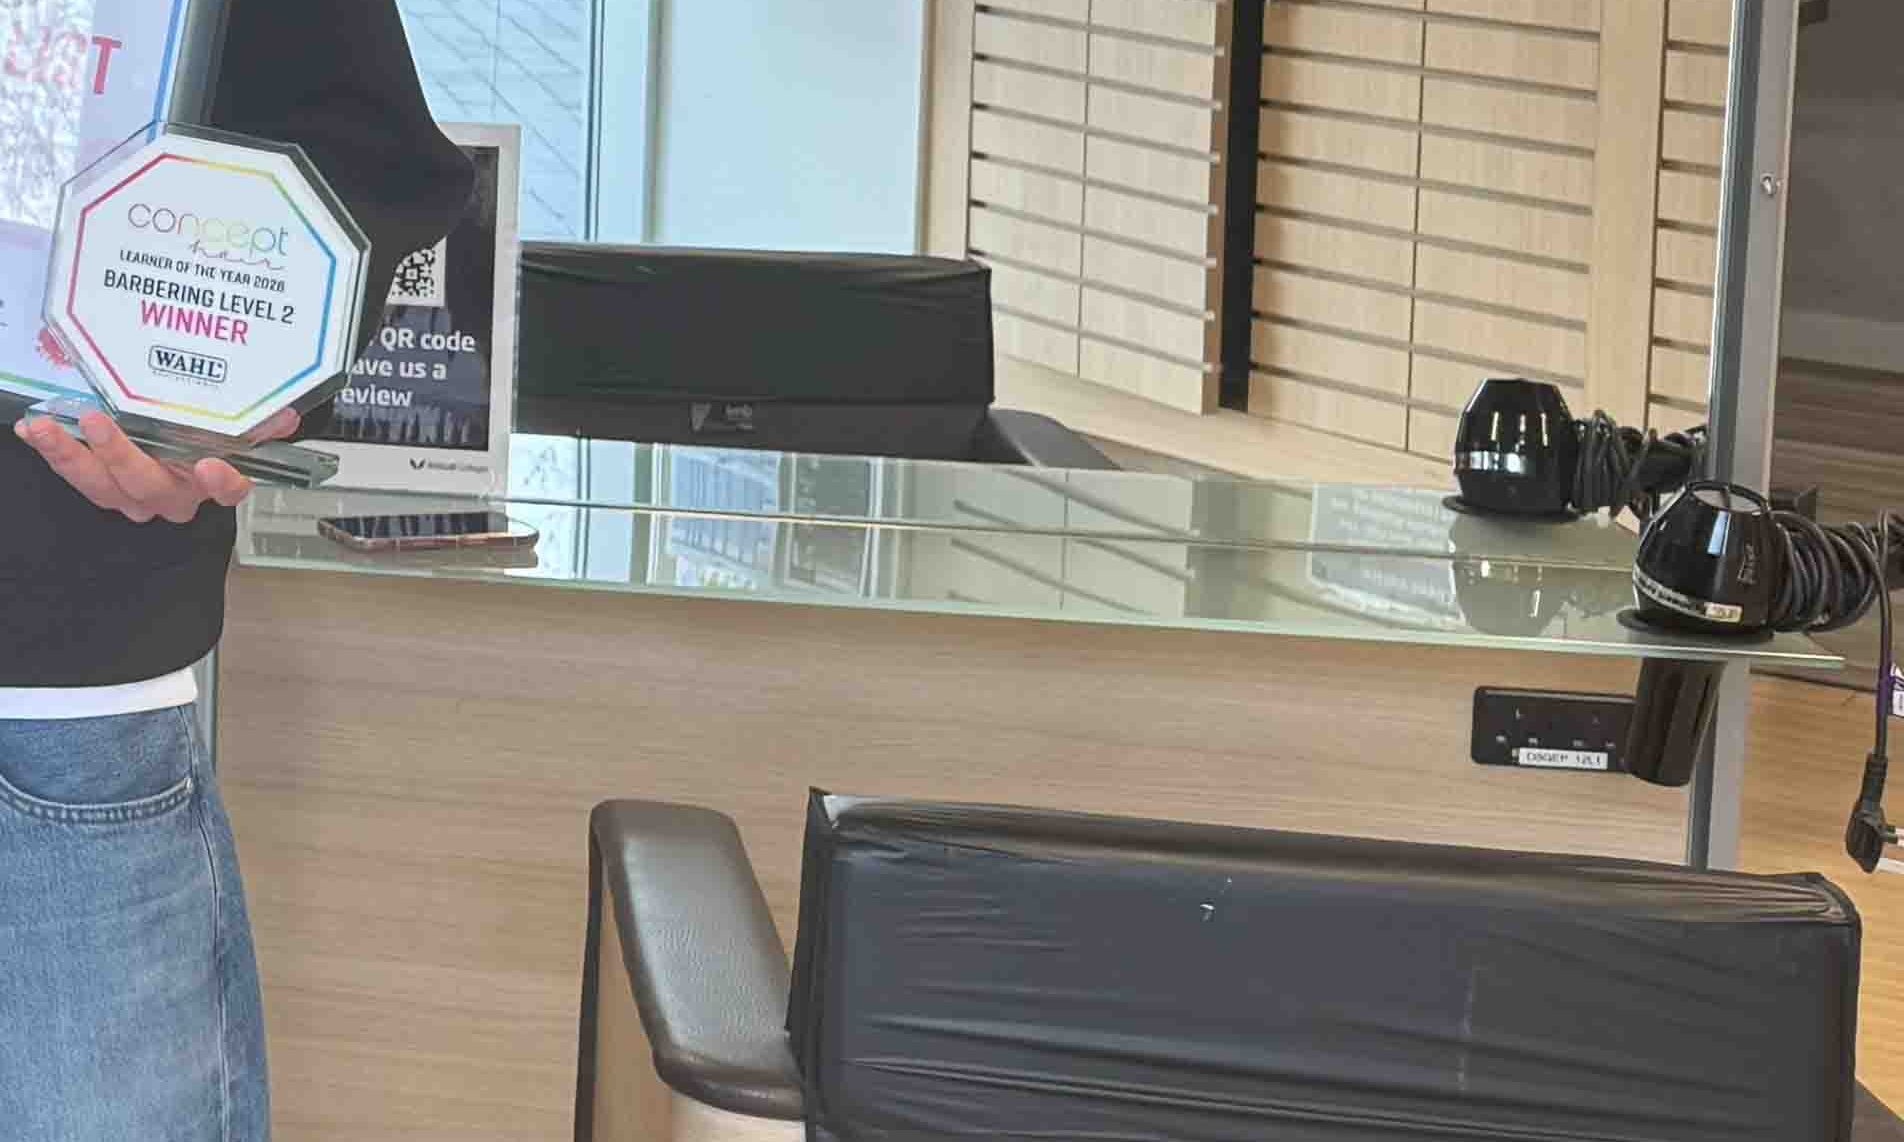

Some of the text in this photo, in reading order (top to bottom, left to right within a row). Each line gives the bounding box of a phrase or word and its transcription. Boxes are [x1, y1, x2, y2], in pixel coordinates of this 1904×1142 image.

[127, 202, 289, 259] concept
[119, 248, 173, 271] LEARNER
[176, 259, 192, 273] OF
[194, 262, 217, 280] THE
[219, 269, 251, 287] YEAR
[103, 267, 295, 326] BARBERING LEVEL 2
[140, 298, 250, 346] WINNER
[379, 326, 477, 353] QR code
[154, 348, 225, 380] WAHL
[350, 357, 448, 381] ave us a
[335, 383, 414, 408] eview
